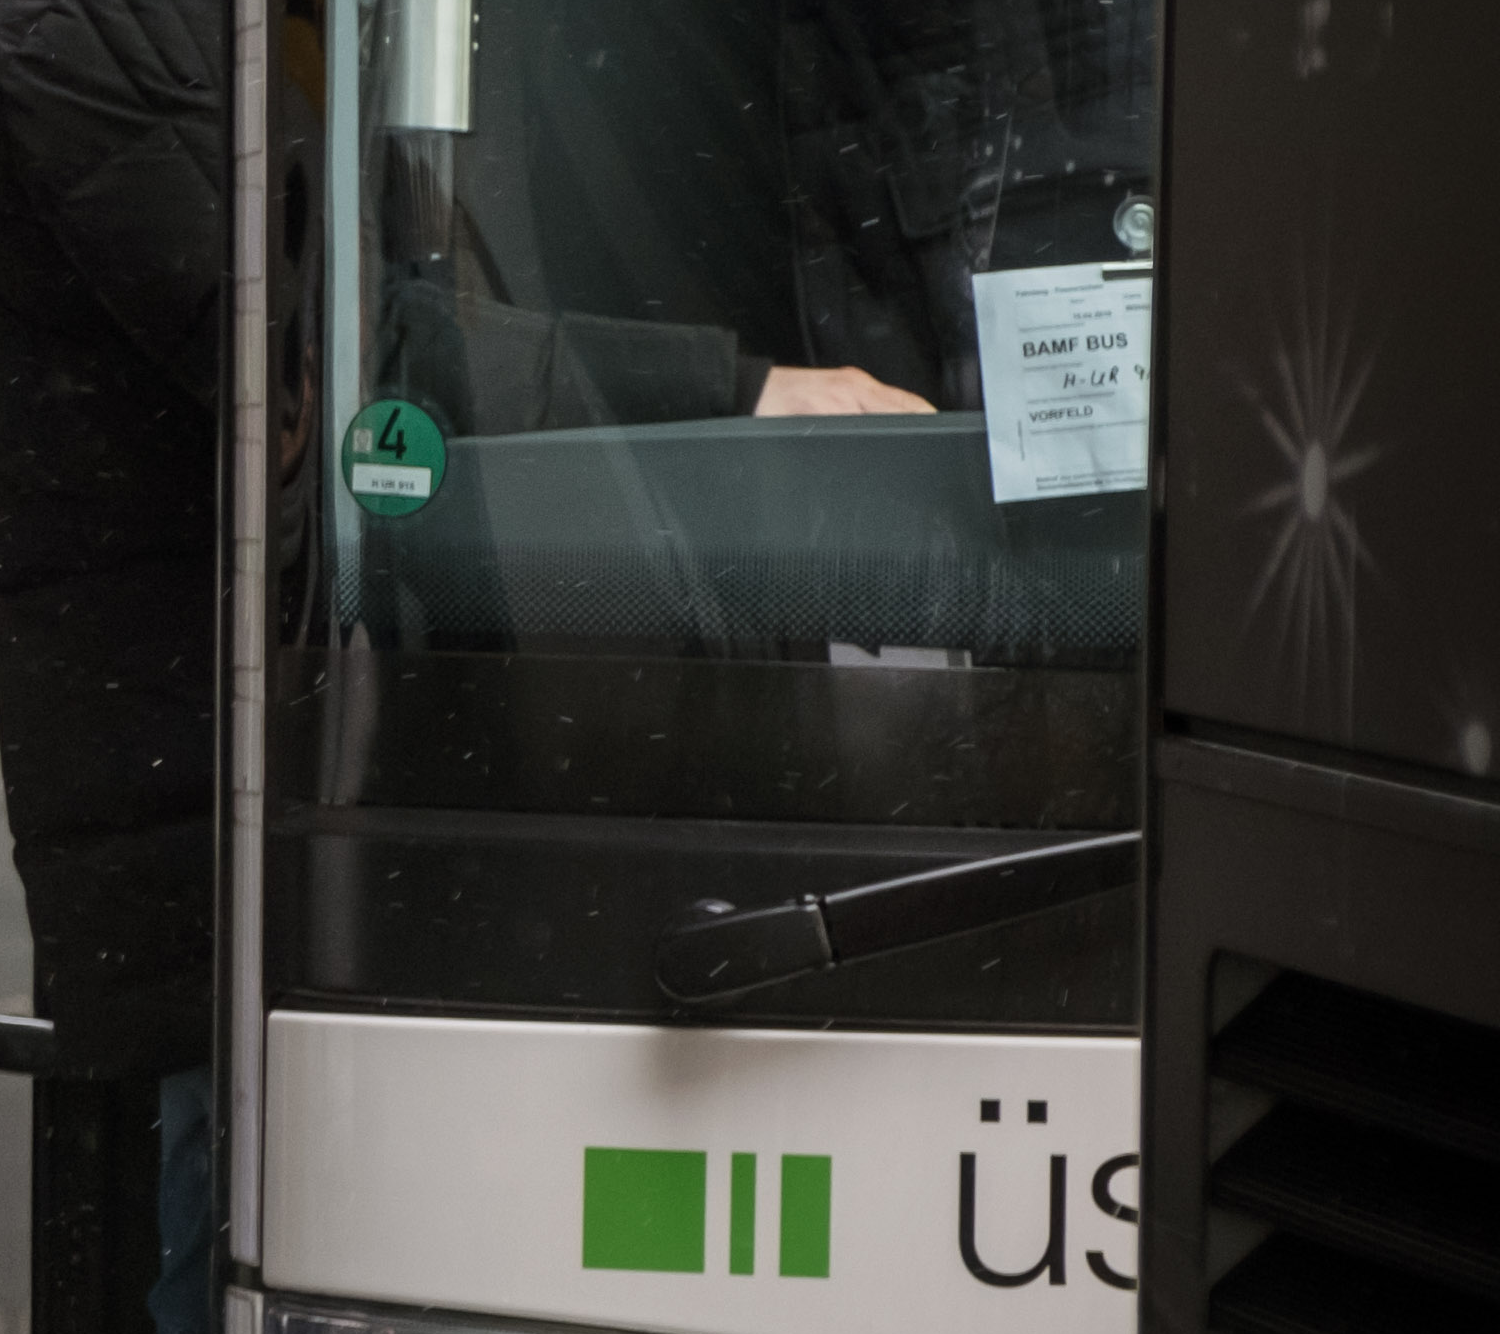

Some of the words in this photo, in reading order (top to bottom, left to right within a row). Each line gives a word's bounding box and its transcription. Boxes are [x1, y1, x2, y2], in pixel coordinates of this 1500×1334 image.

[1021, 336, 1078, 358] BAMF
[1086, 332, 1129, 351] BUS
[1028, 404, 1094, 423] VORFELD
[377, 406, 407, 460] 4
